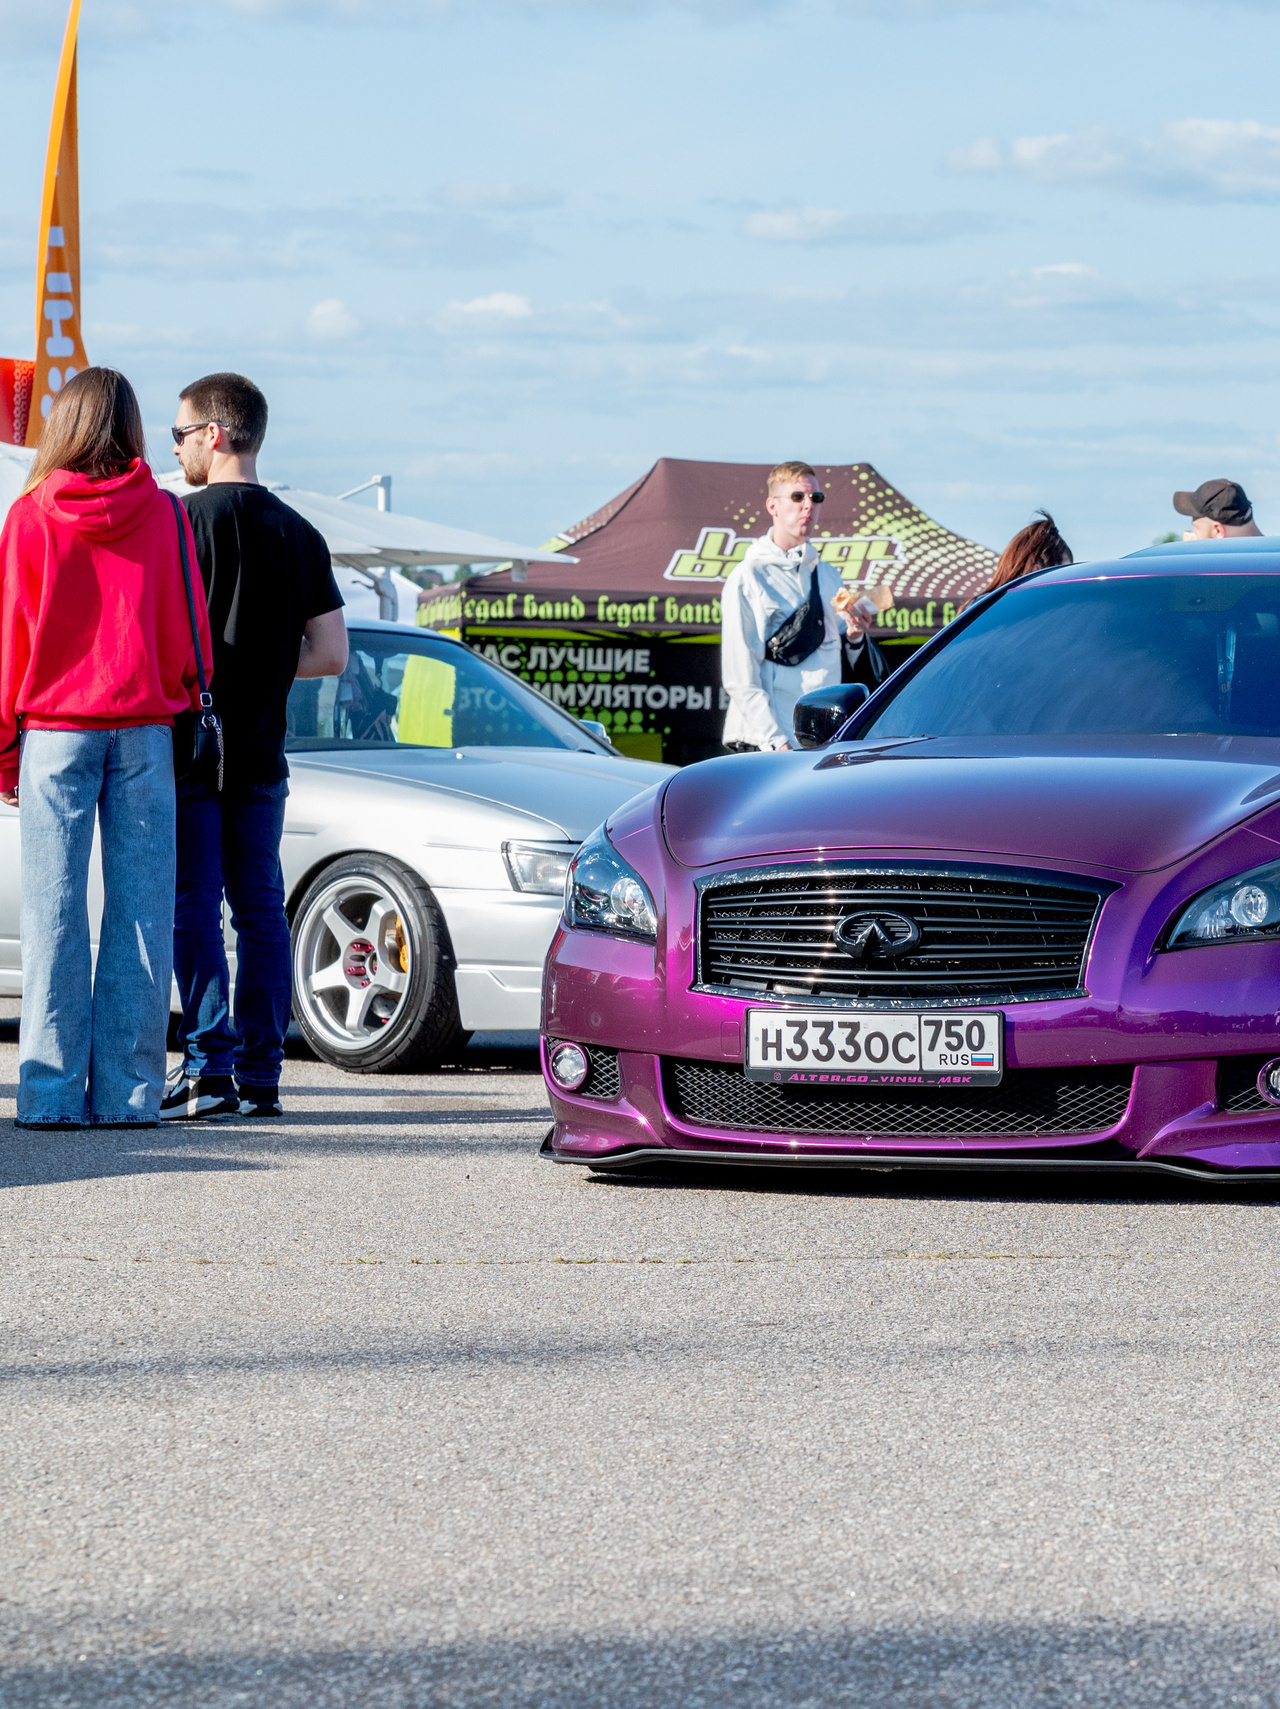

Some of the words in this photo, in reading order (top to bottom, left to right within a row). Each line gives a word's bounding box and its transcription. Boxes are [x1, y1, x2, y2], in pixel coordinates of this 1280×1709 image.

[524, 593, 585, 620] band
[597, 595, 658, 628] legal
[665, 596, 722, 623] band
[472, 643, 521, 669] АС
[527, 646, 650, 673] ЛУЧШИЕ
[923, 1019, 985, 1052] 750
[939, 1053, 969, 1066] RUS
